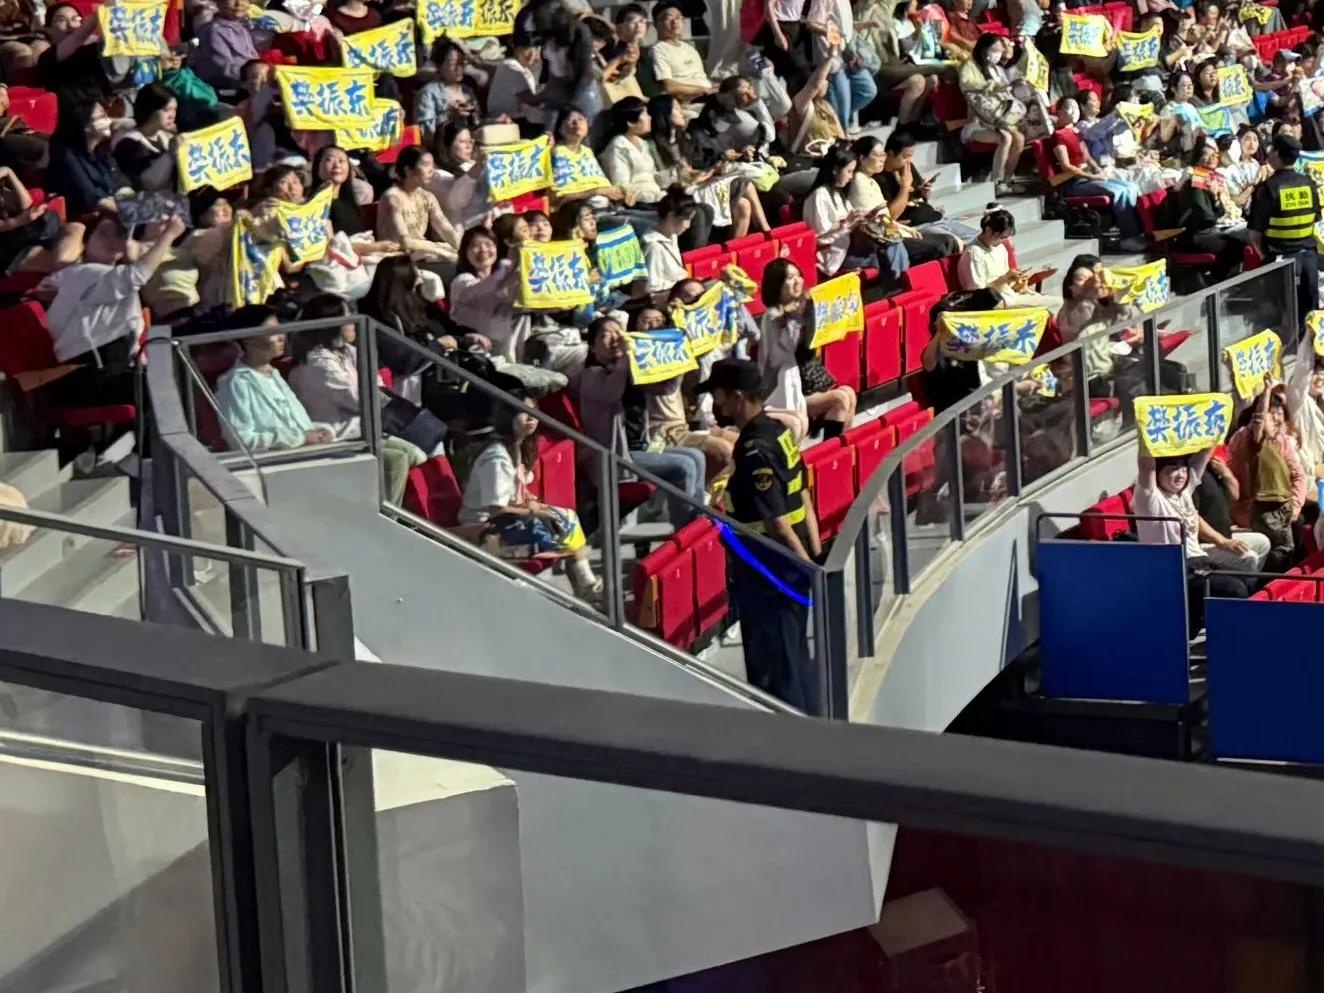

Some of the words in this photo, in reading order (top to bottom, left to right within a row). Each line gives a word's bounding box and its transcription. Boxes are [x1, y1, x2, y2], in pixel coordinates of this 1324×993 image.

[290, 79, 372, 116] 樊振东
[188, 128, 250, 184] 樊振东
[947, 318, 1039, 354] 樊振东
[1147, 397, 1228, 443] 樊振东
